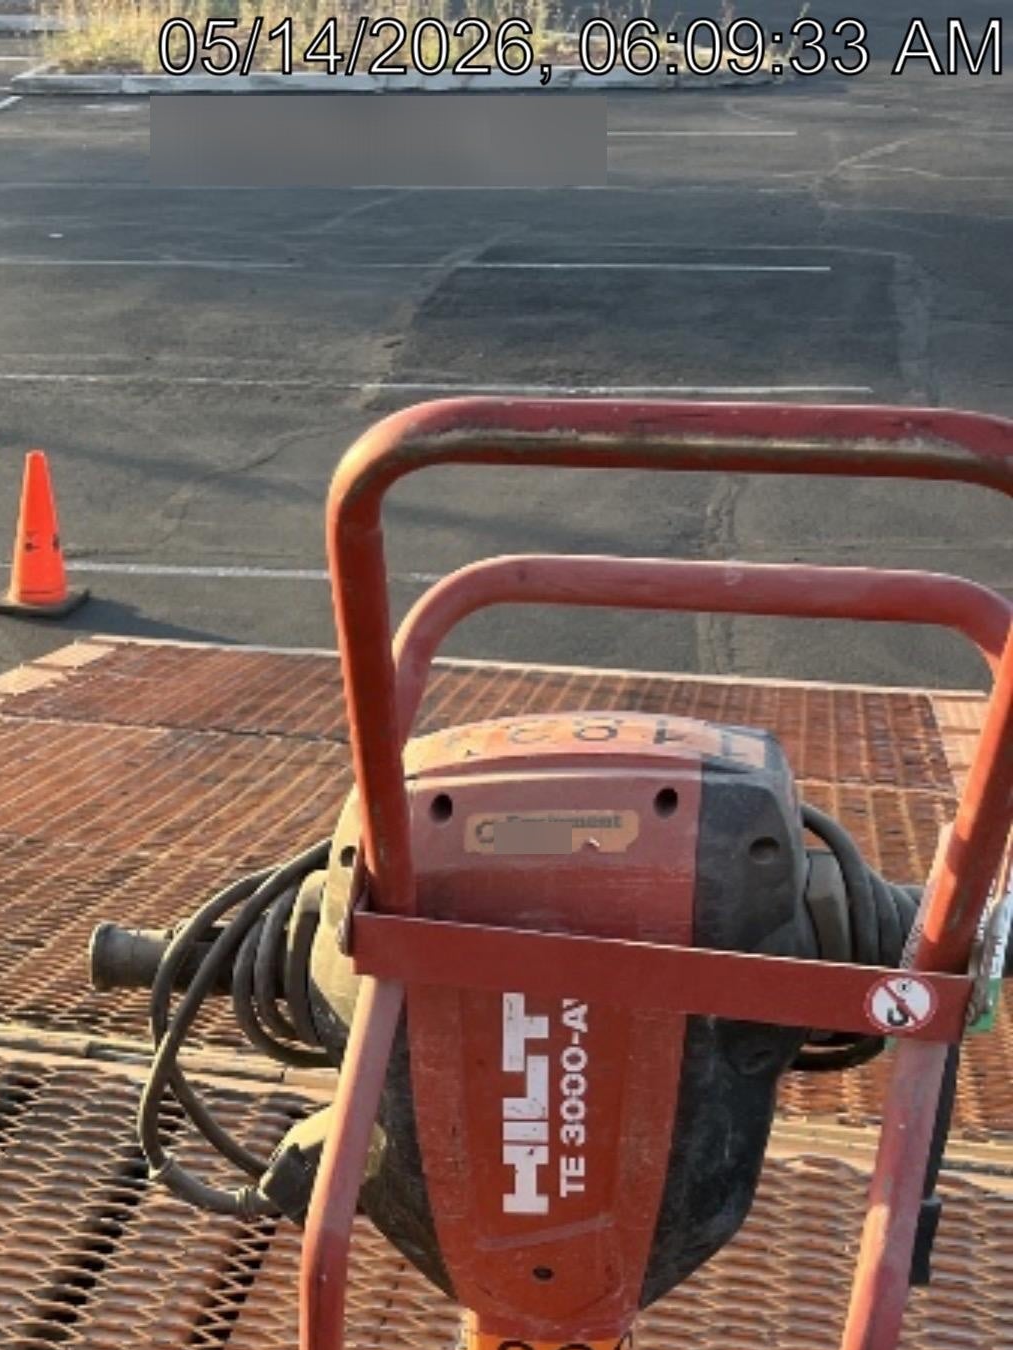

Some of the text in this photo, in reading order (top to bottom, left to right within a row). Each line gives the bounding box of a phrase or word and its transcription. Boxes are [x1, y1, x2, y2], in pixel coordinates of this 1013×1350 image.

[502, 992, 549, 1213] HILT
[559, 998, 589, 1198] TE 3000-A
